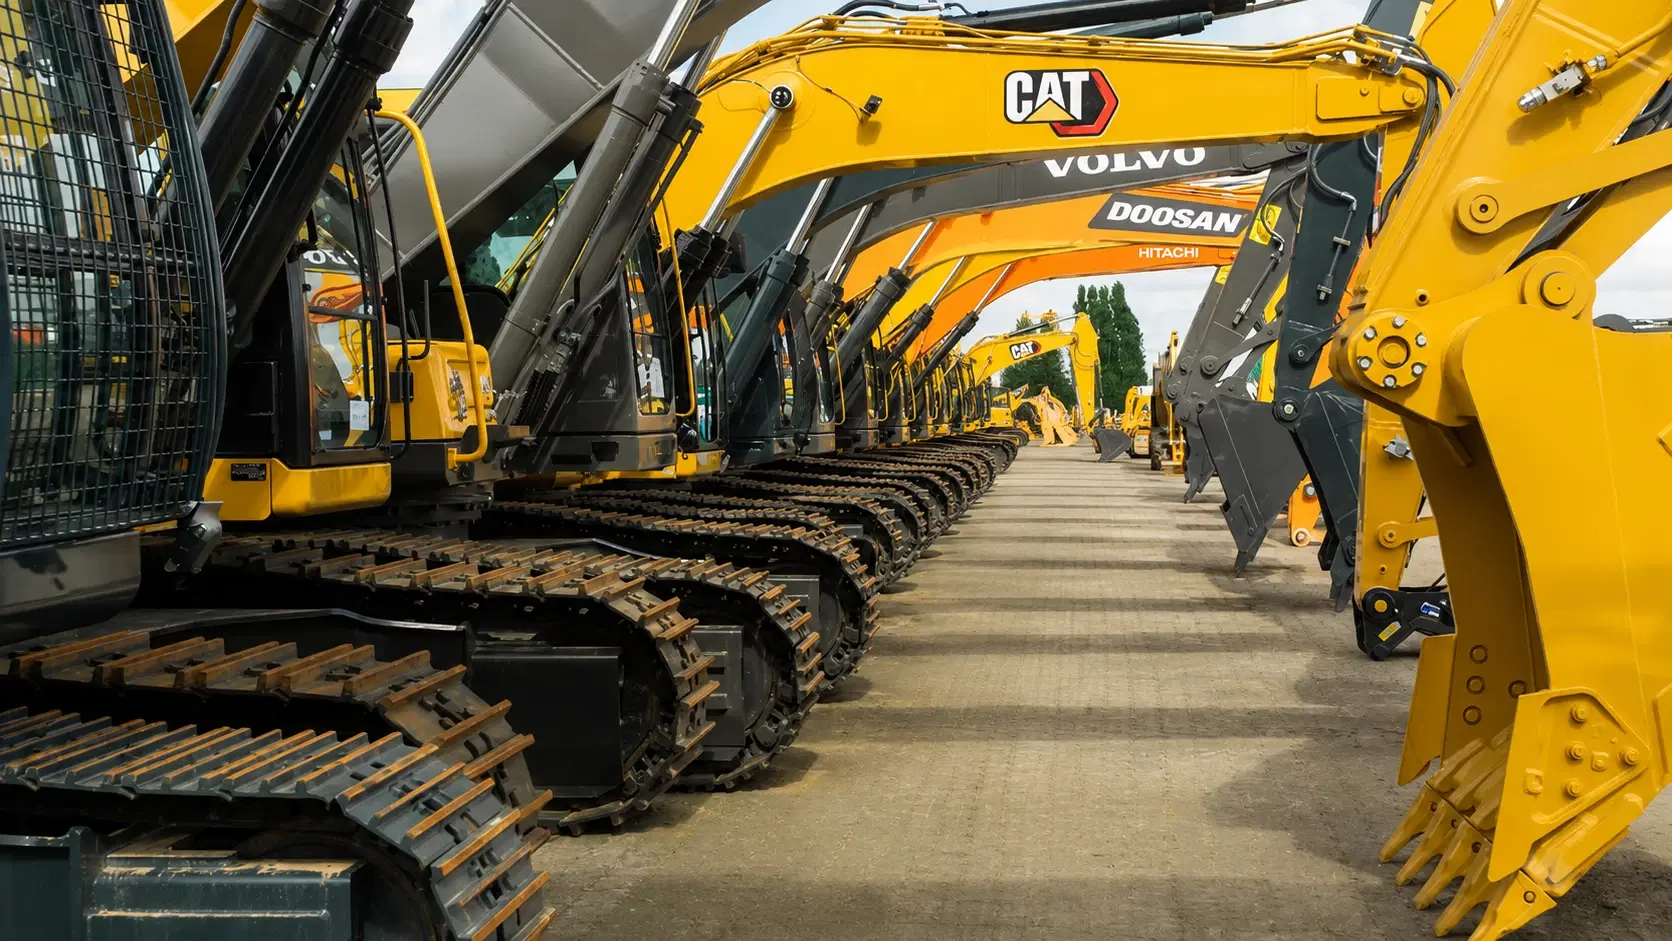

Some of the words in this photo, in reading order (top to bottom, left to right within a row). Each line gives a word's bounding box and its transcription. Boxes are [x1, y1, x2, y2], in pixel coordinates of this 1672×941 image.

[1006, 71, 1089, 122] CAT
[1044, 147, 1206, 178] VOLVO
[1107, 201, 1242, 232] DOOSAN
[1139, 247, 1199, 259] HITACHI
[1011, 341, 1034, 359] CAT
